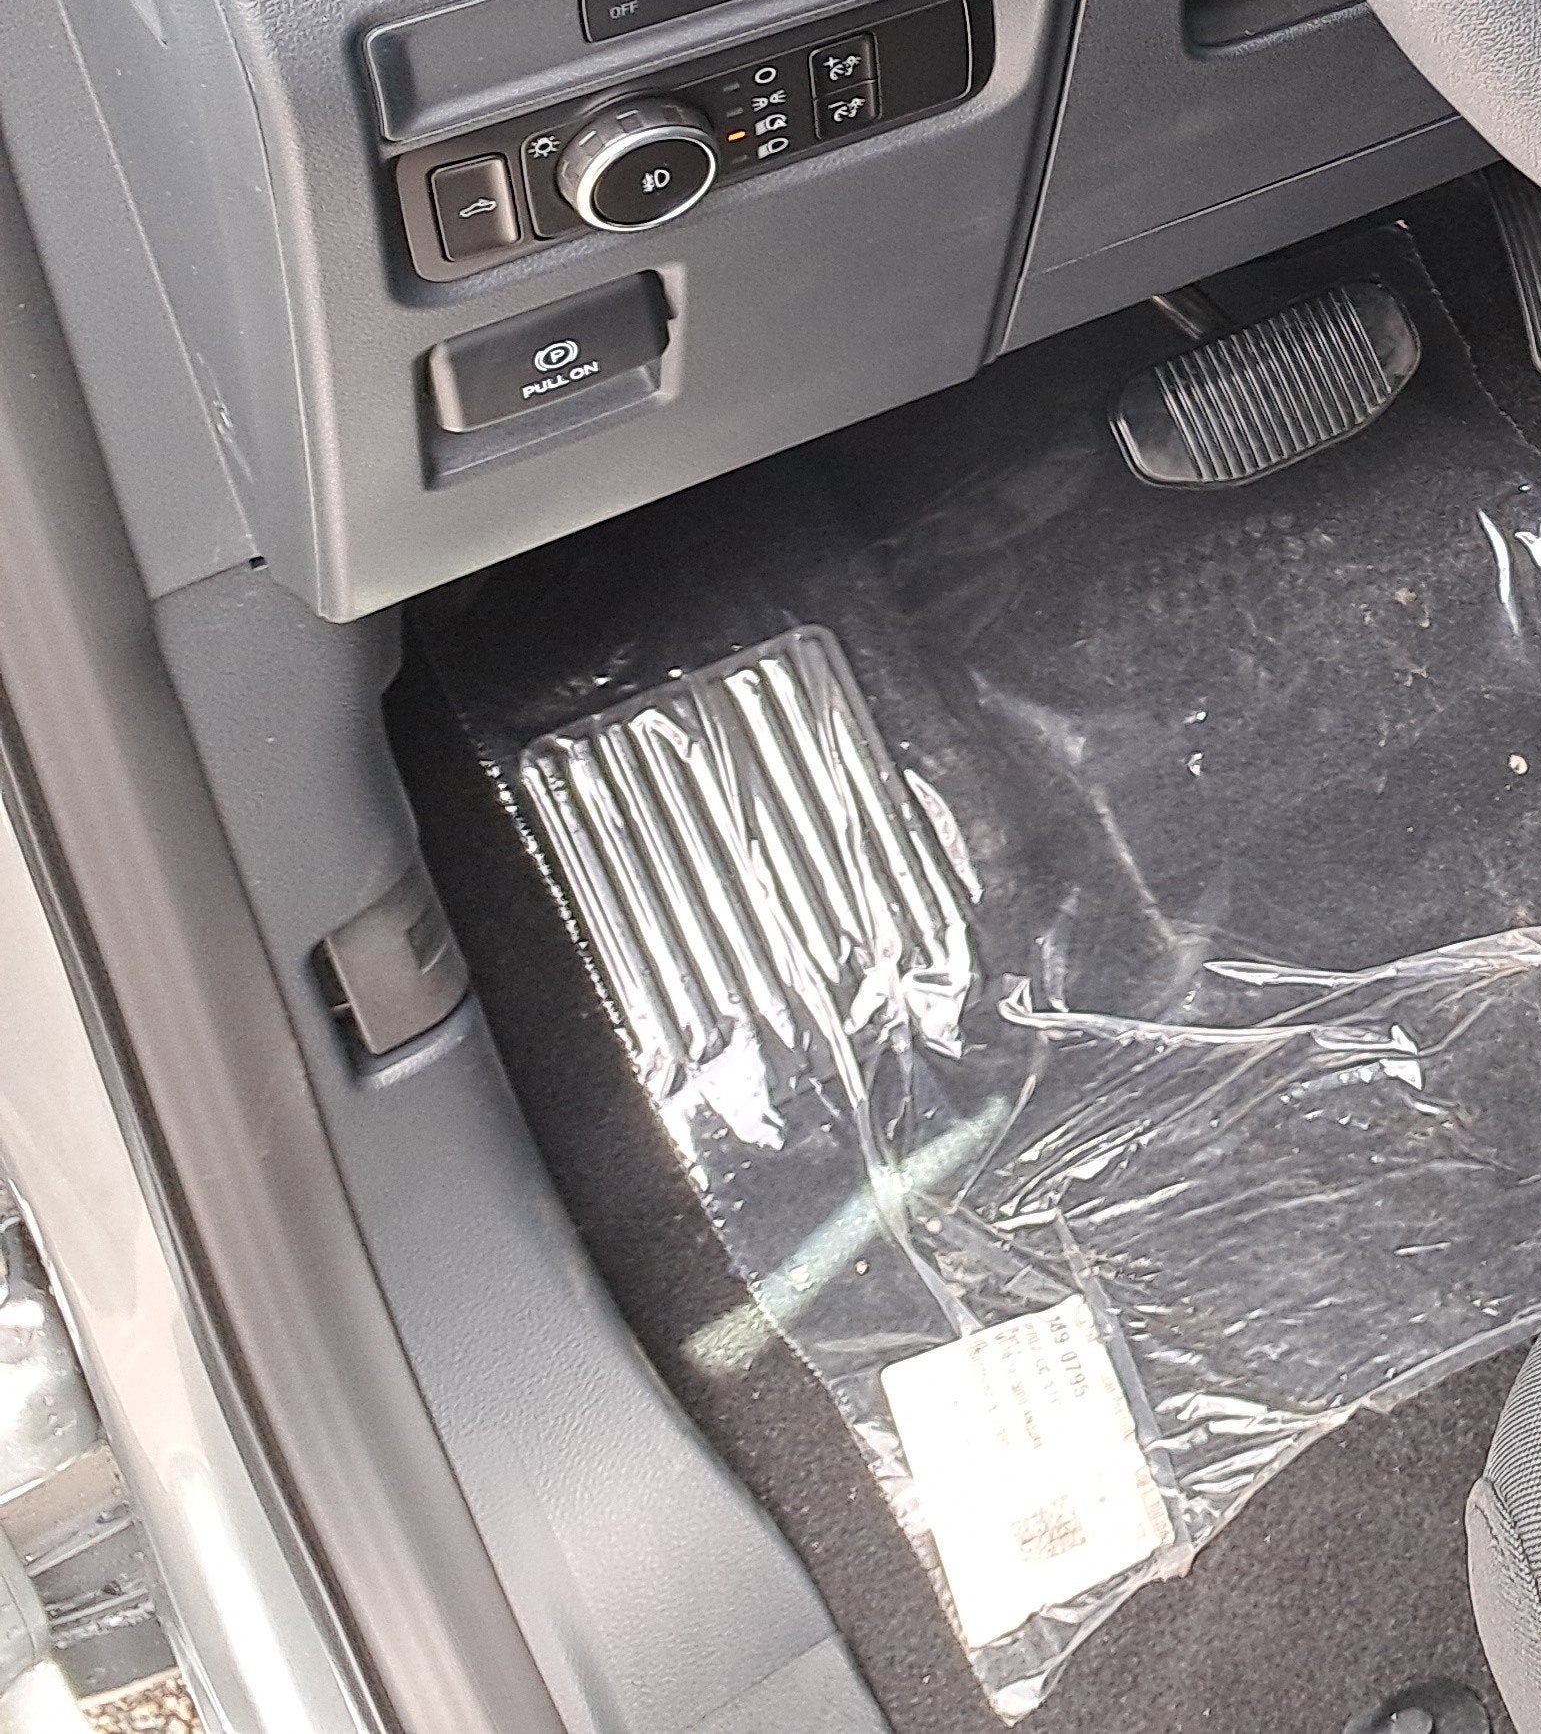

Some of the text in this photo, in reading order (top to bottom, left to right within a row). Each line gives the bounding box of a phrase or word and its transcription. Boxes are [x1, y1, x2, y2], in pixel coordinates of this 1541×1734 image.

[608, 0, 640, 21] OFF
[522, 360, 600, 400] PULL ON
